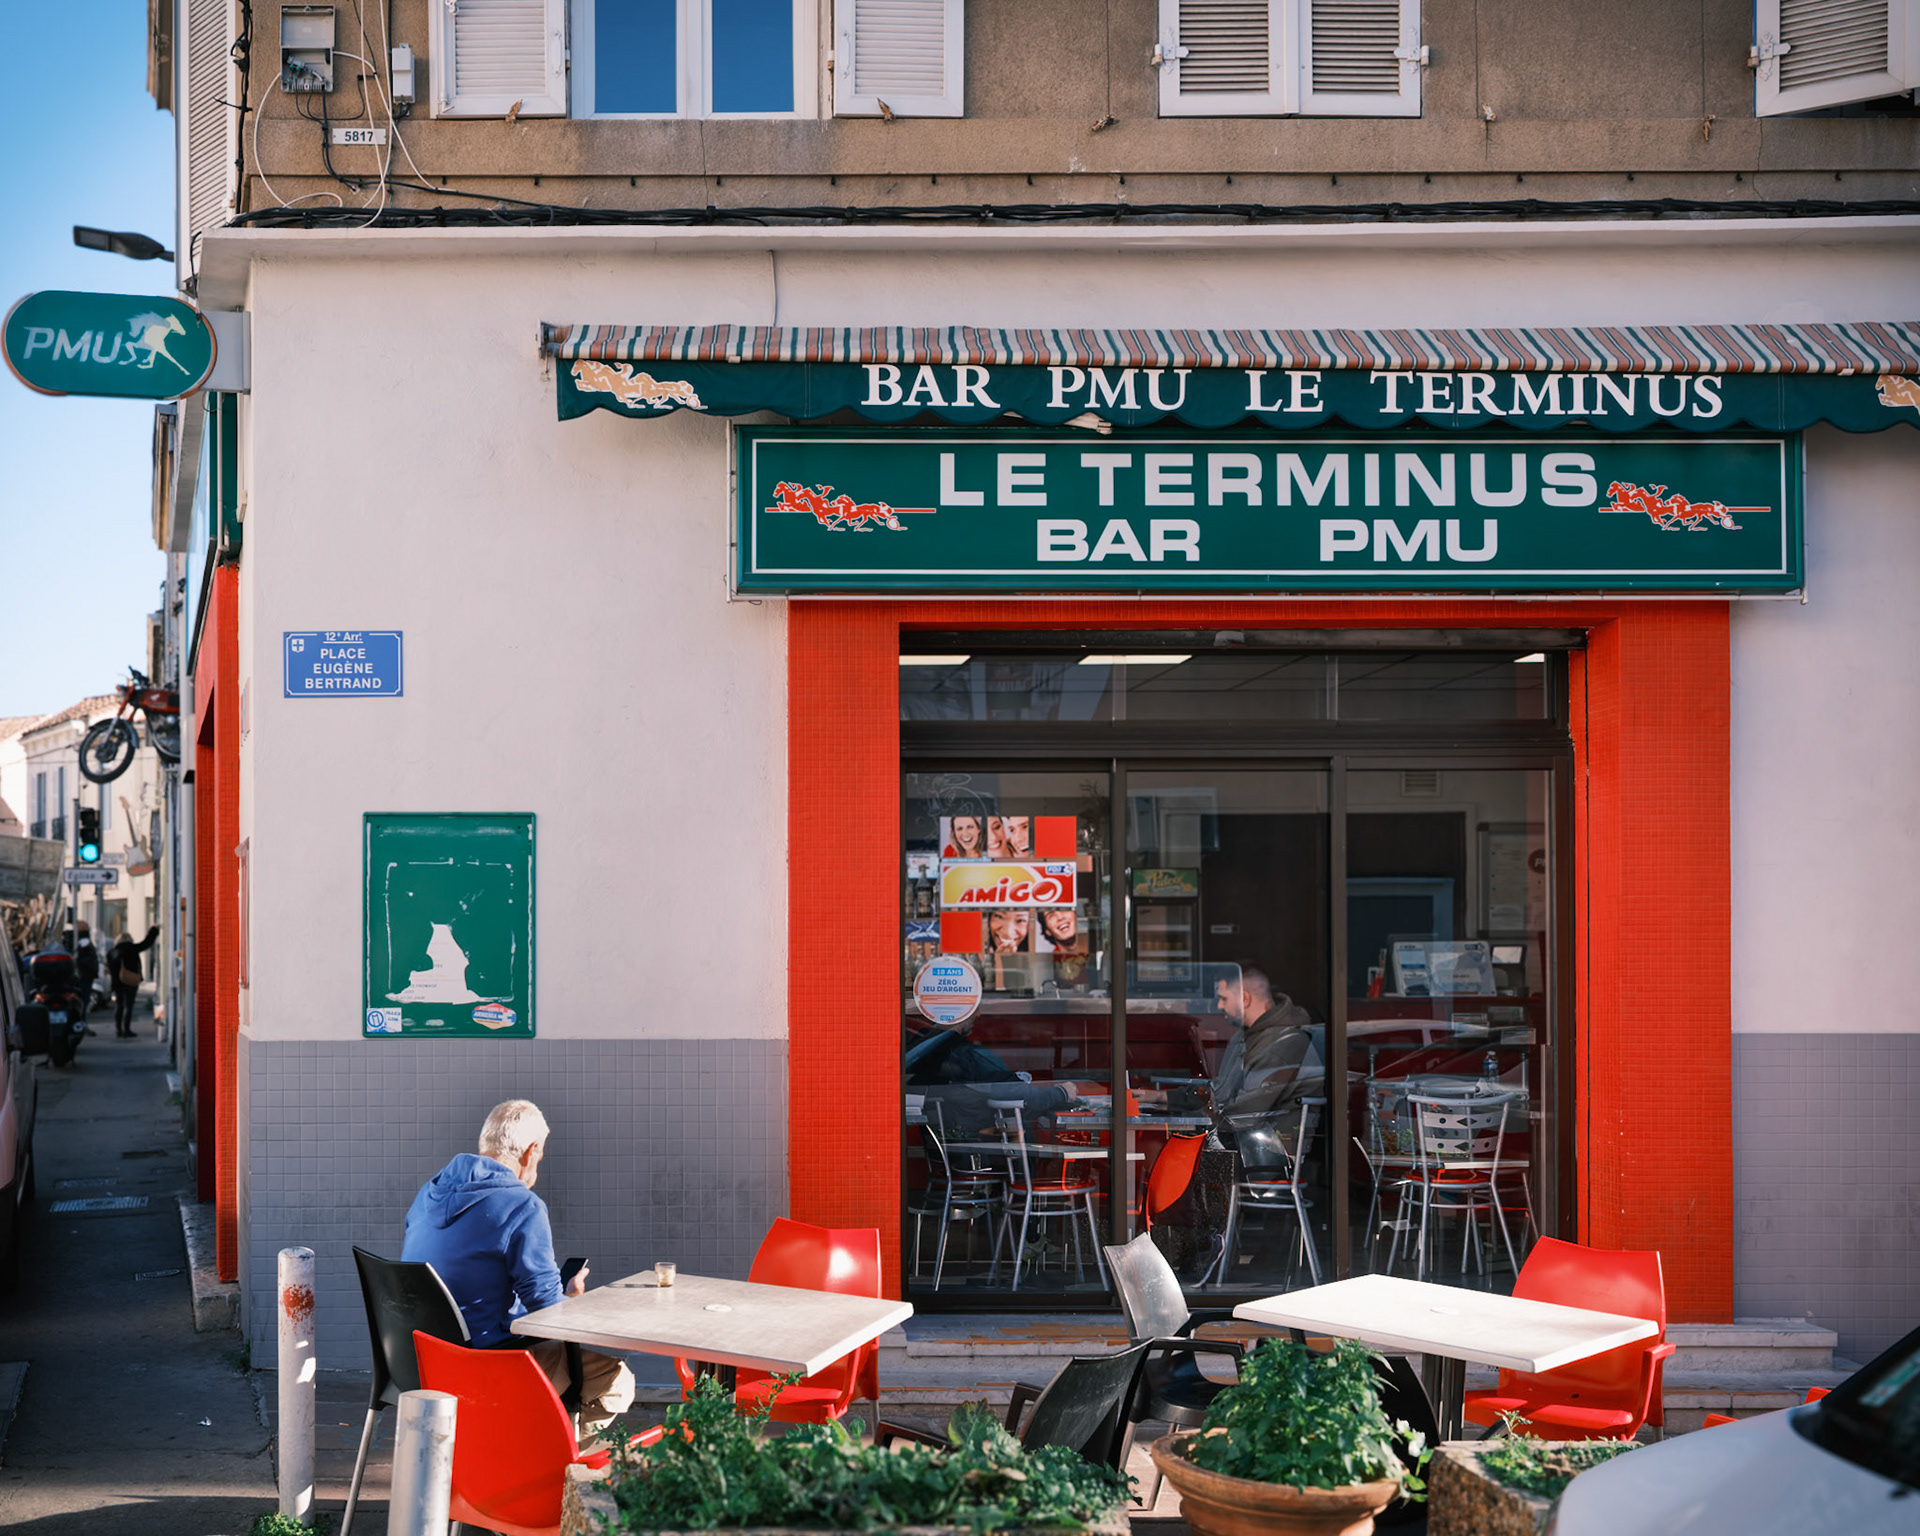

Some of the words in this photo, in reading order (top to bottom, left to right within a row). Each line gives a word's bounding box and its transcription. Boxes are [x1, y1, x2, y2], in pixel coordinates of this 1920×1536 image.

[344, 130, 374, 142] 5817
[24, 327, 123, 364] PMU
[861, 365, 1000, 408] BAR
[1047, 366, 1192, 411] PMU
[1245, 370, 1324, 413] LE
[1371, 371, 1723, 419] TERMINUS
[940, 453, 1047, 506] LE
[1081, 452, 1598, 507] TERMINUS
[1037, 519, 1200, 562] BAR
[1319, 519, 1498, 562] PMU
[320, 648, 366, 659] PLACE
[313, 661, 374, 674] EUGÈNE
[305, 678, 382, 689] BERTRAND
[937, 978, 958, 986] ZÉRO
